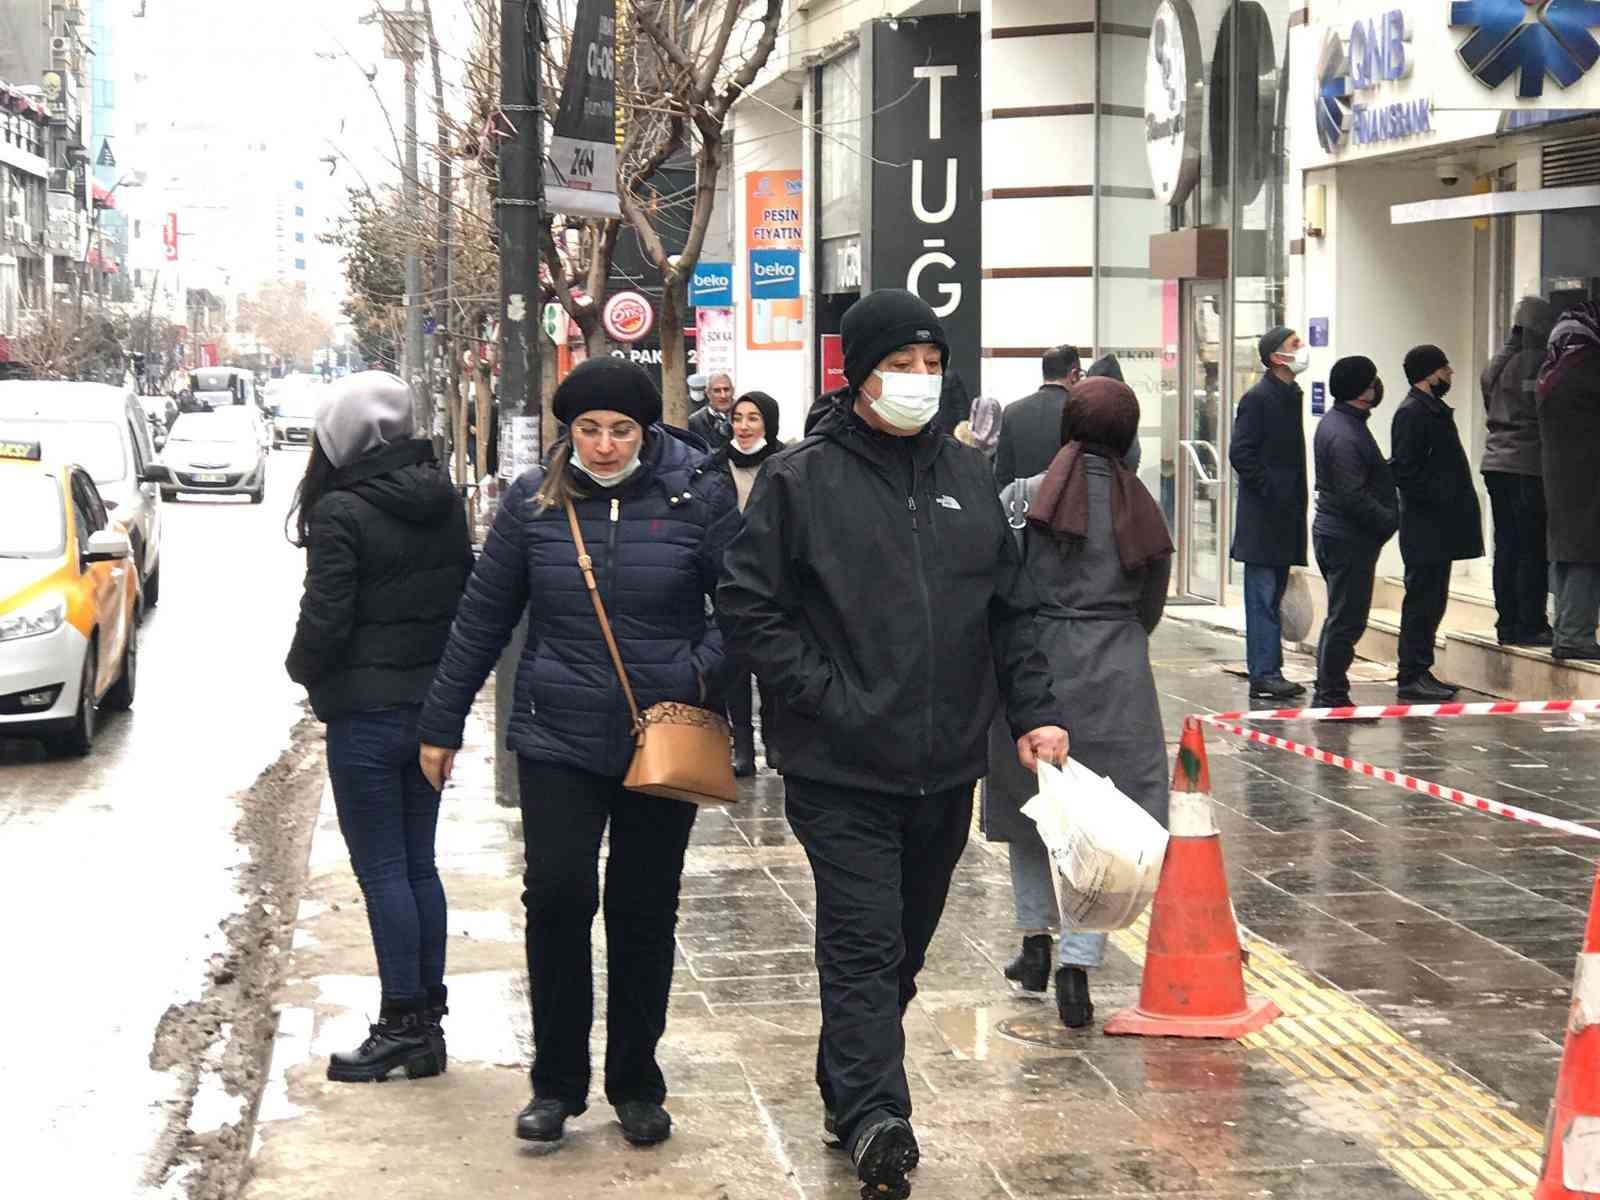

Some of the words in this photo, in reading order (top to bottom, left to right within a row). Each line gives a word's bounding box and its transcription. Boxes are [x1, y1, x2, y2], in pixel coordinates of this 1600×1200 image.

[1348, 9, 1405, 89] QNB
[755, 263, 795, 277] beko
[694, 275, 729, 287] beko
